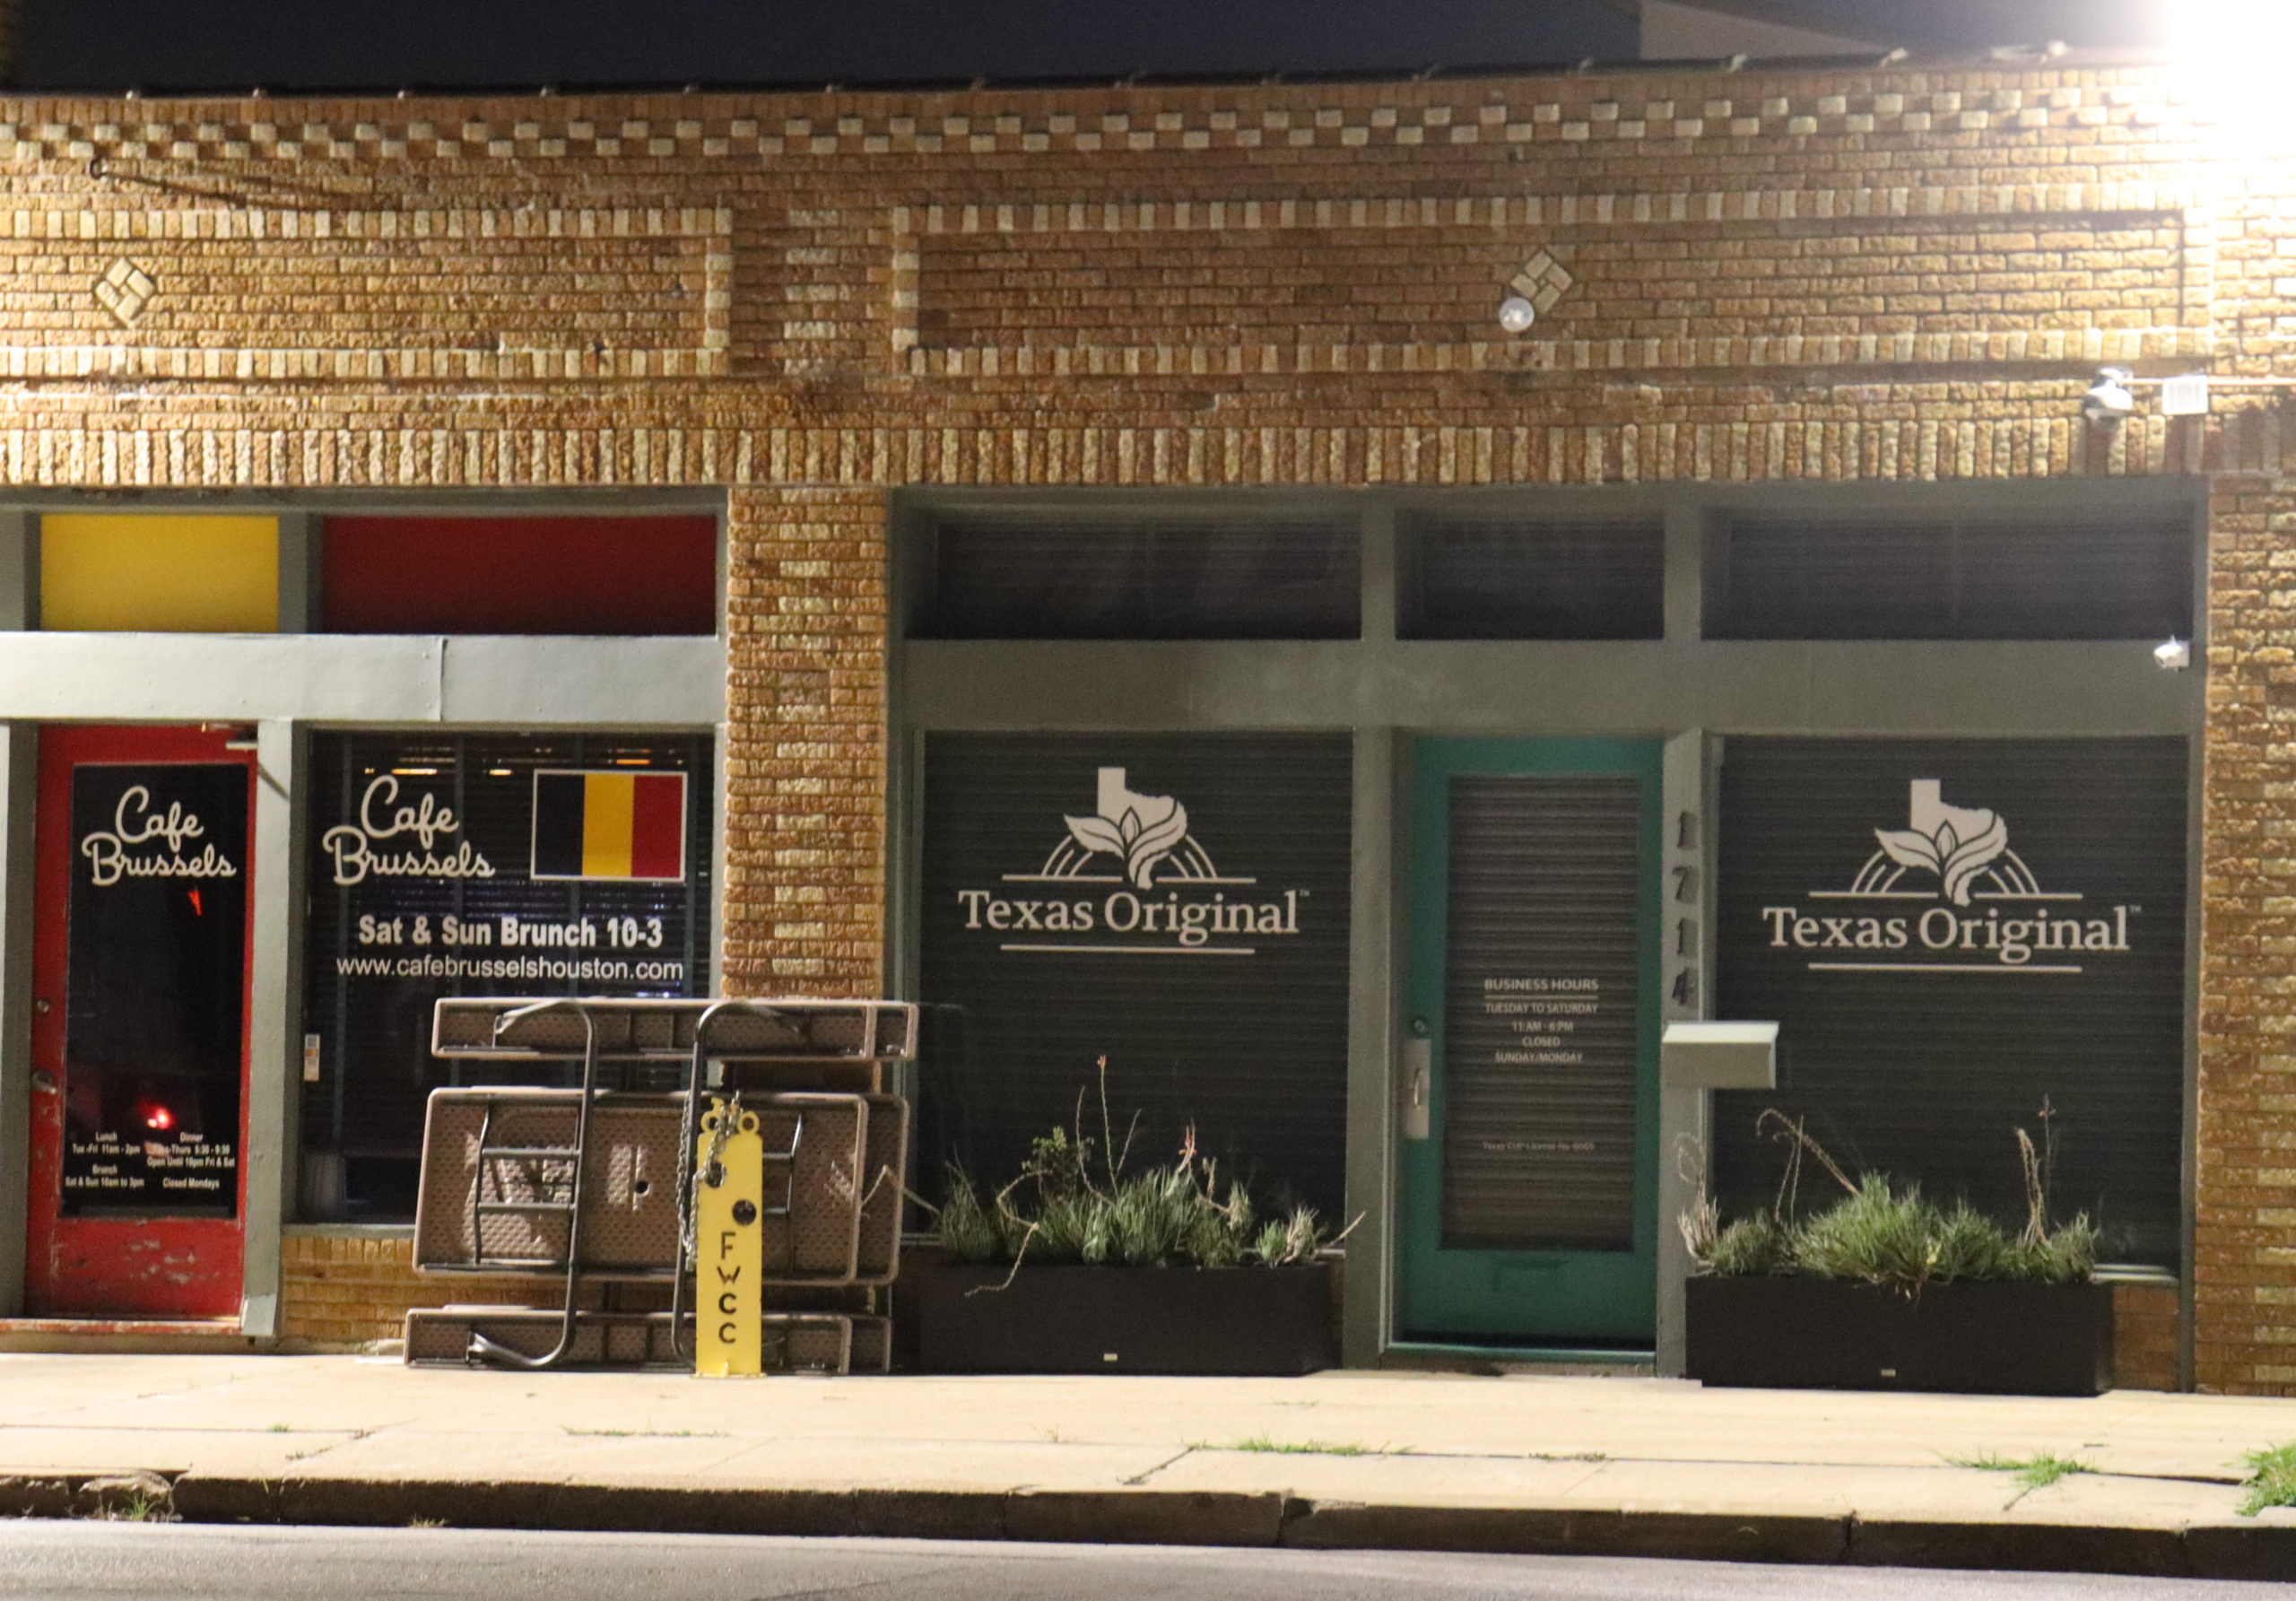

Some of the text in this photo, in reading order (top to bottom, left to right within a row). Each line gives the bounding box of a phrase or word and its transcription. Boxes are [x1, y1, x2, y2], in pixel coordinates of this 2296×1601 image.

[115, 786, 204, 852] Cafe
[361, 775, 459, 850] Cafe
[82, 831, 237, 886] Brussels
[322, 825, 496, 886] Brussels
[958, 890, 1093, 931] Texas
[359, 915, 663, 948] Sat & Sun Brunch 10-3
[1762, 907, 1909, 948] Texas
[336, 953, 683, 980] www.cafebrusselshouston.com
[1484, 979, 1598, 990] BUSINESS HOURS
[1485, 1002, 1597, 1014] TUESDAY TO SATURDAY
[1522, 1036, 1561, 1048] CLOSED
[95, 1131, 117, 1142] Lunch
[180, 1131, 204, 1143] Dinner
[92, 1164, 117, 1175] Brunch
[147, 1156, 166, 1168] Open
[163, 1177, 220, 1190] Closed Mondays
[717, 1231, 742, 1344] FWCC
